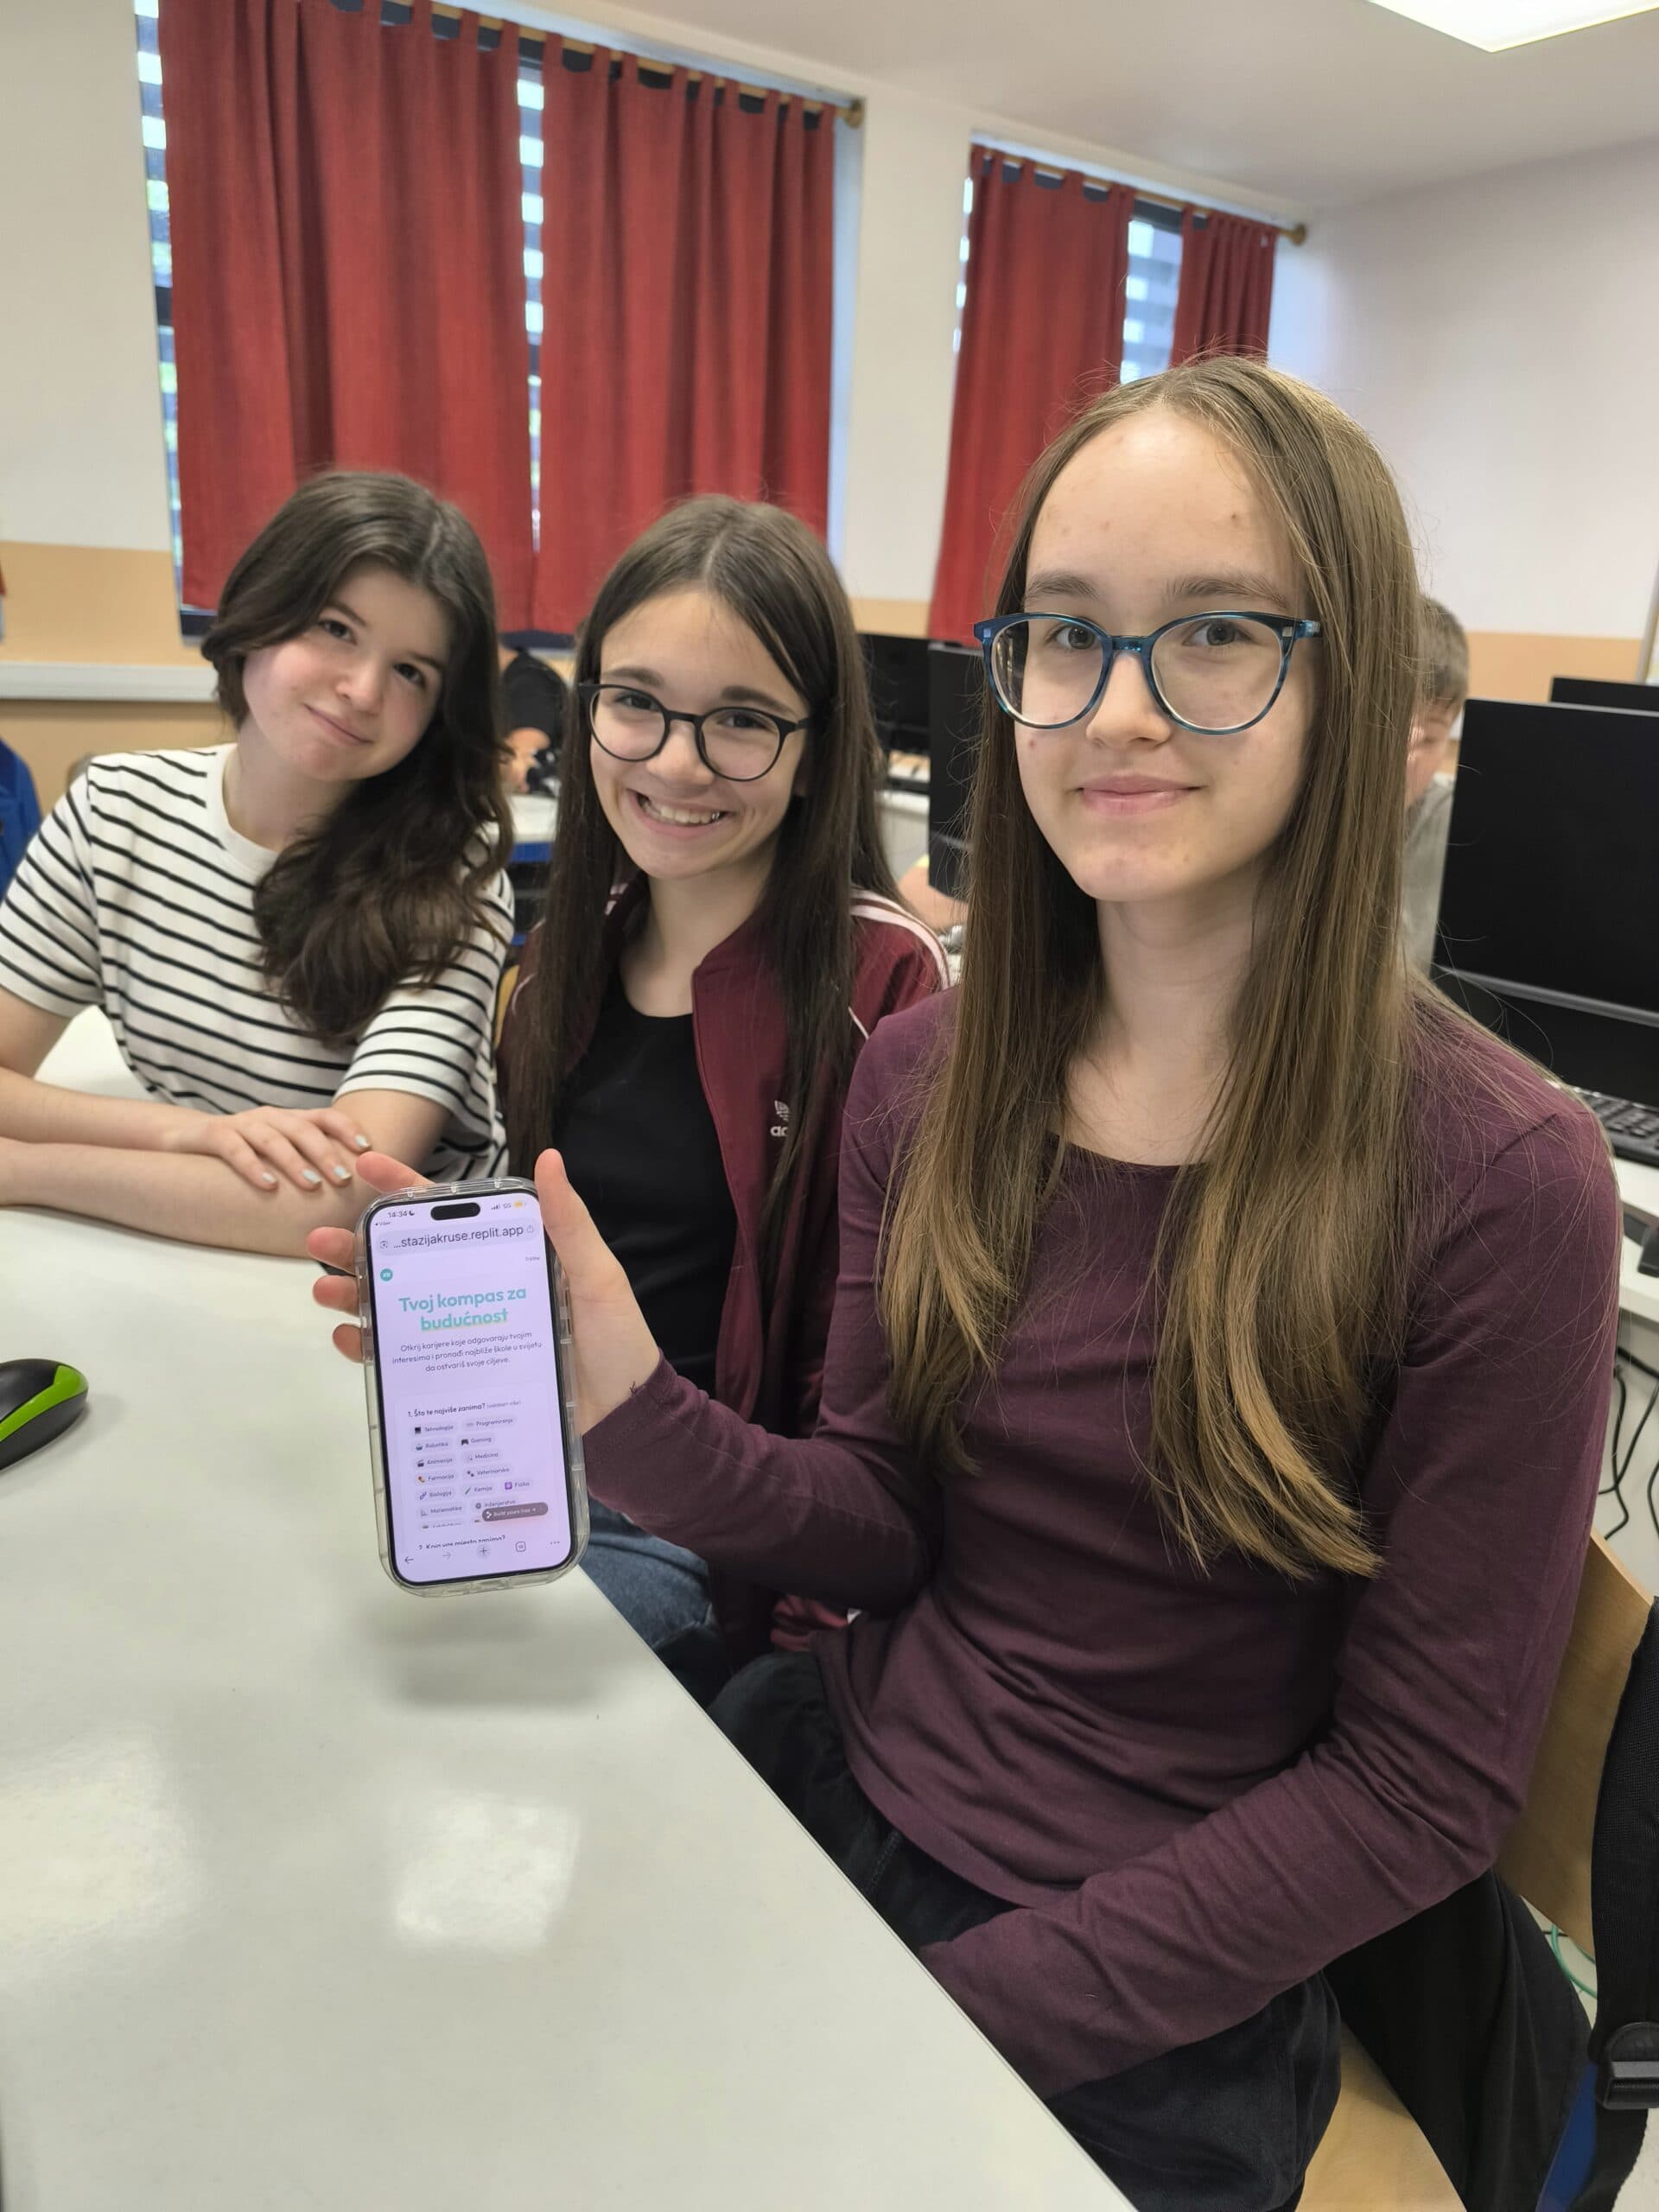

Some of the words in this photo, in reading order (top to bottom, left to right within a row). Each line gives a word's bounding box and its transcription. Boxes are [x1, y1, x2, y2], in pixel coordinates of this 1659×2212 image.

[399, 1295, 434, 1313] Tvoj
[438, 1291, 504, 1307] kompas
[507, 1287, 526, 1300] za
[421, 1308, 508, 1331] budućnost
[423, 1340, 450, 1351] karijere
[451, 1338, 466, 1347] koje
[467, 1334, 509, 1344] odgovaraju
[510, 1332, 532, 1341] tvojim
[392, 1355, 430, 1364] interesima
[435, 1350, 463, 1362] pronađi
[465, 1347, 493, 1357] najbliže
[494, 1344, 512, 1353] škole
[518, 1342, 542, 1352] svijetu
[436, 1361, 466, 1370] ostvariš
[467, 1359, 485, 1369] svoje
[414, 1408, 425, 1417] Što
[434, 1406, 457, 1415] najviše
[458, 1403, 485, 1412] zanima?
